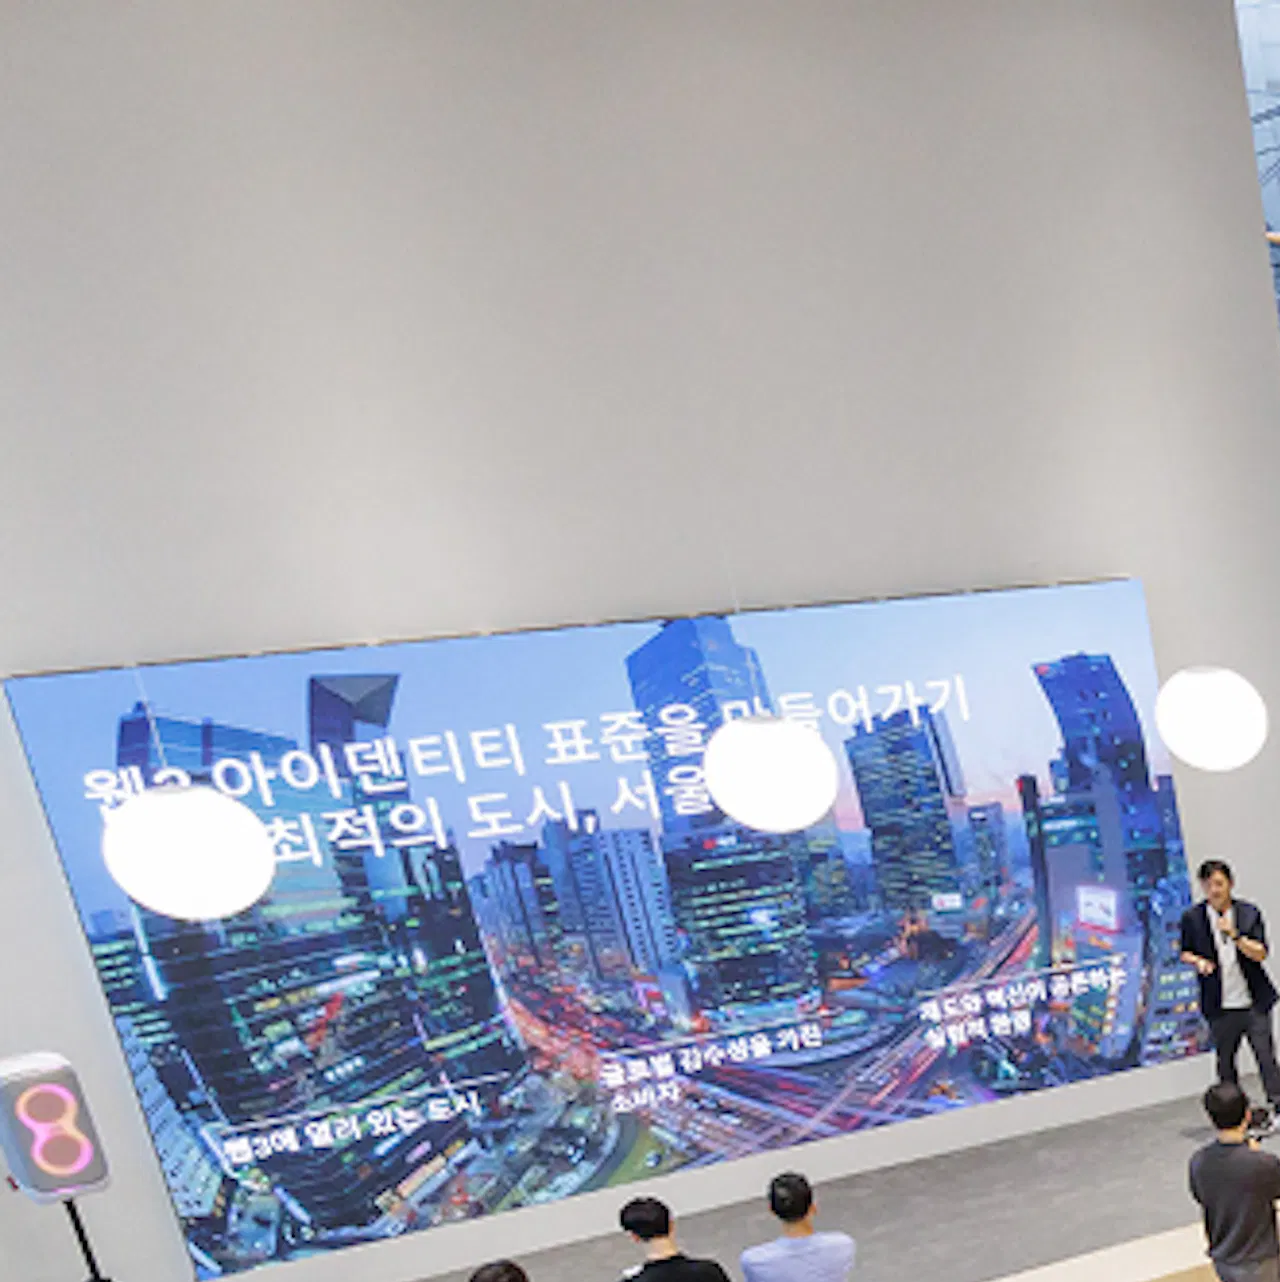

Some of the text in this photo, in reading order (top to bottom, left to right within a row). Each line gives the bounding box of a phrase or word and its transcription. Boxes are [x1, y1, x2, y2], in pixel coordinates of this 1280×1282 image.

[212, 723, 526, 808] 아이덴티티
[543, 703, 708, 765] 표준을
[265, 765, 712, 867] 최적의 도시, 서울
[427, 1090, 483, 1121] 도시
